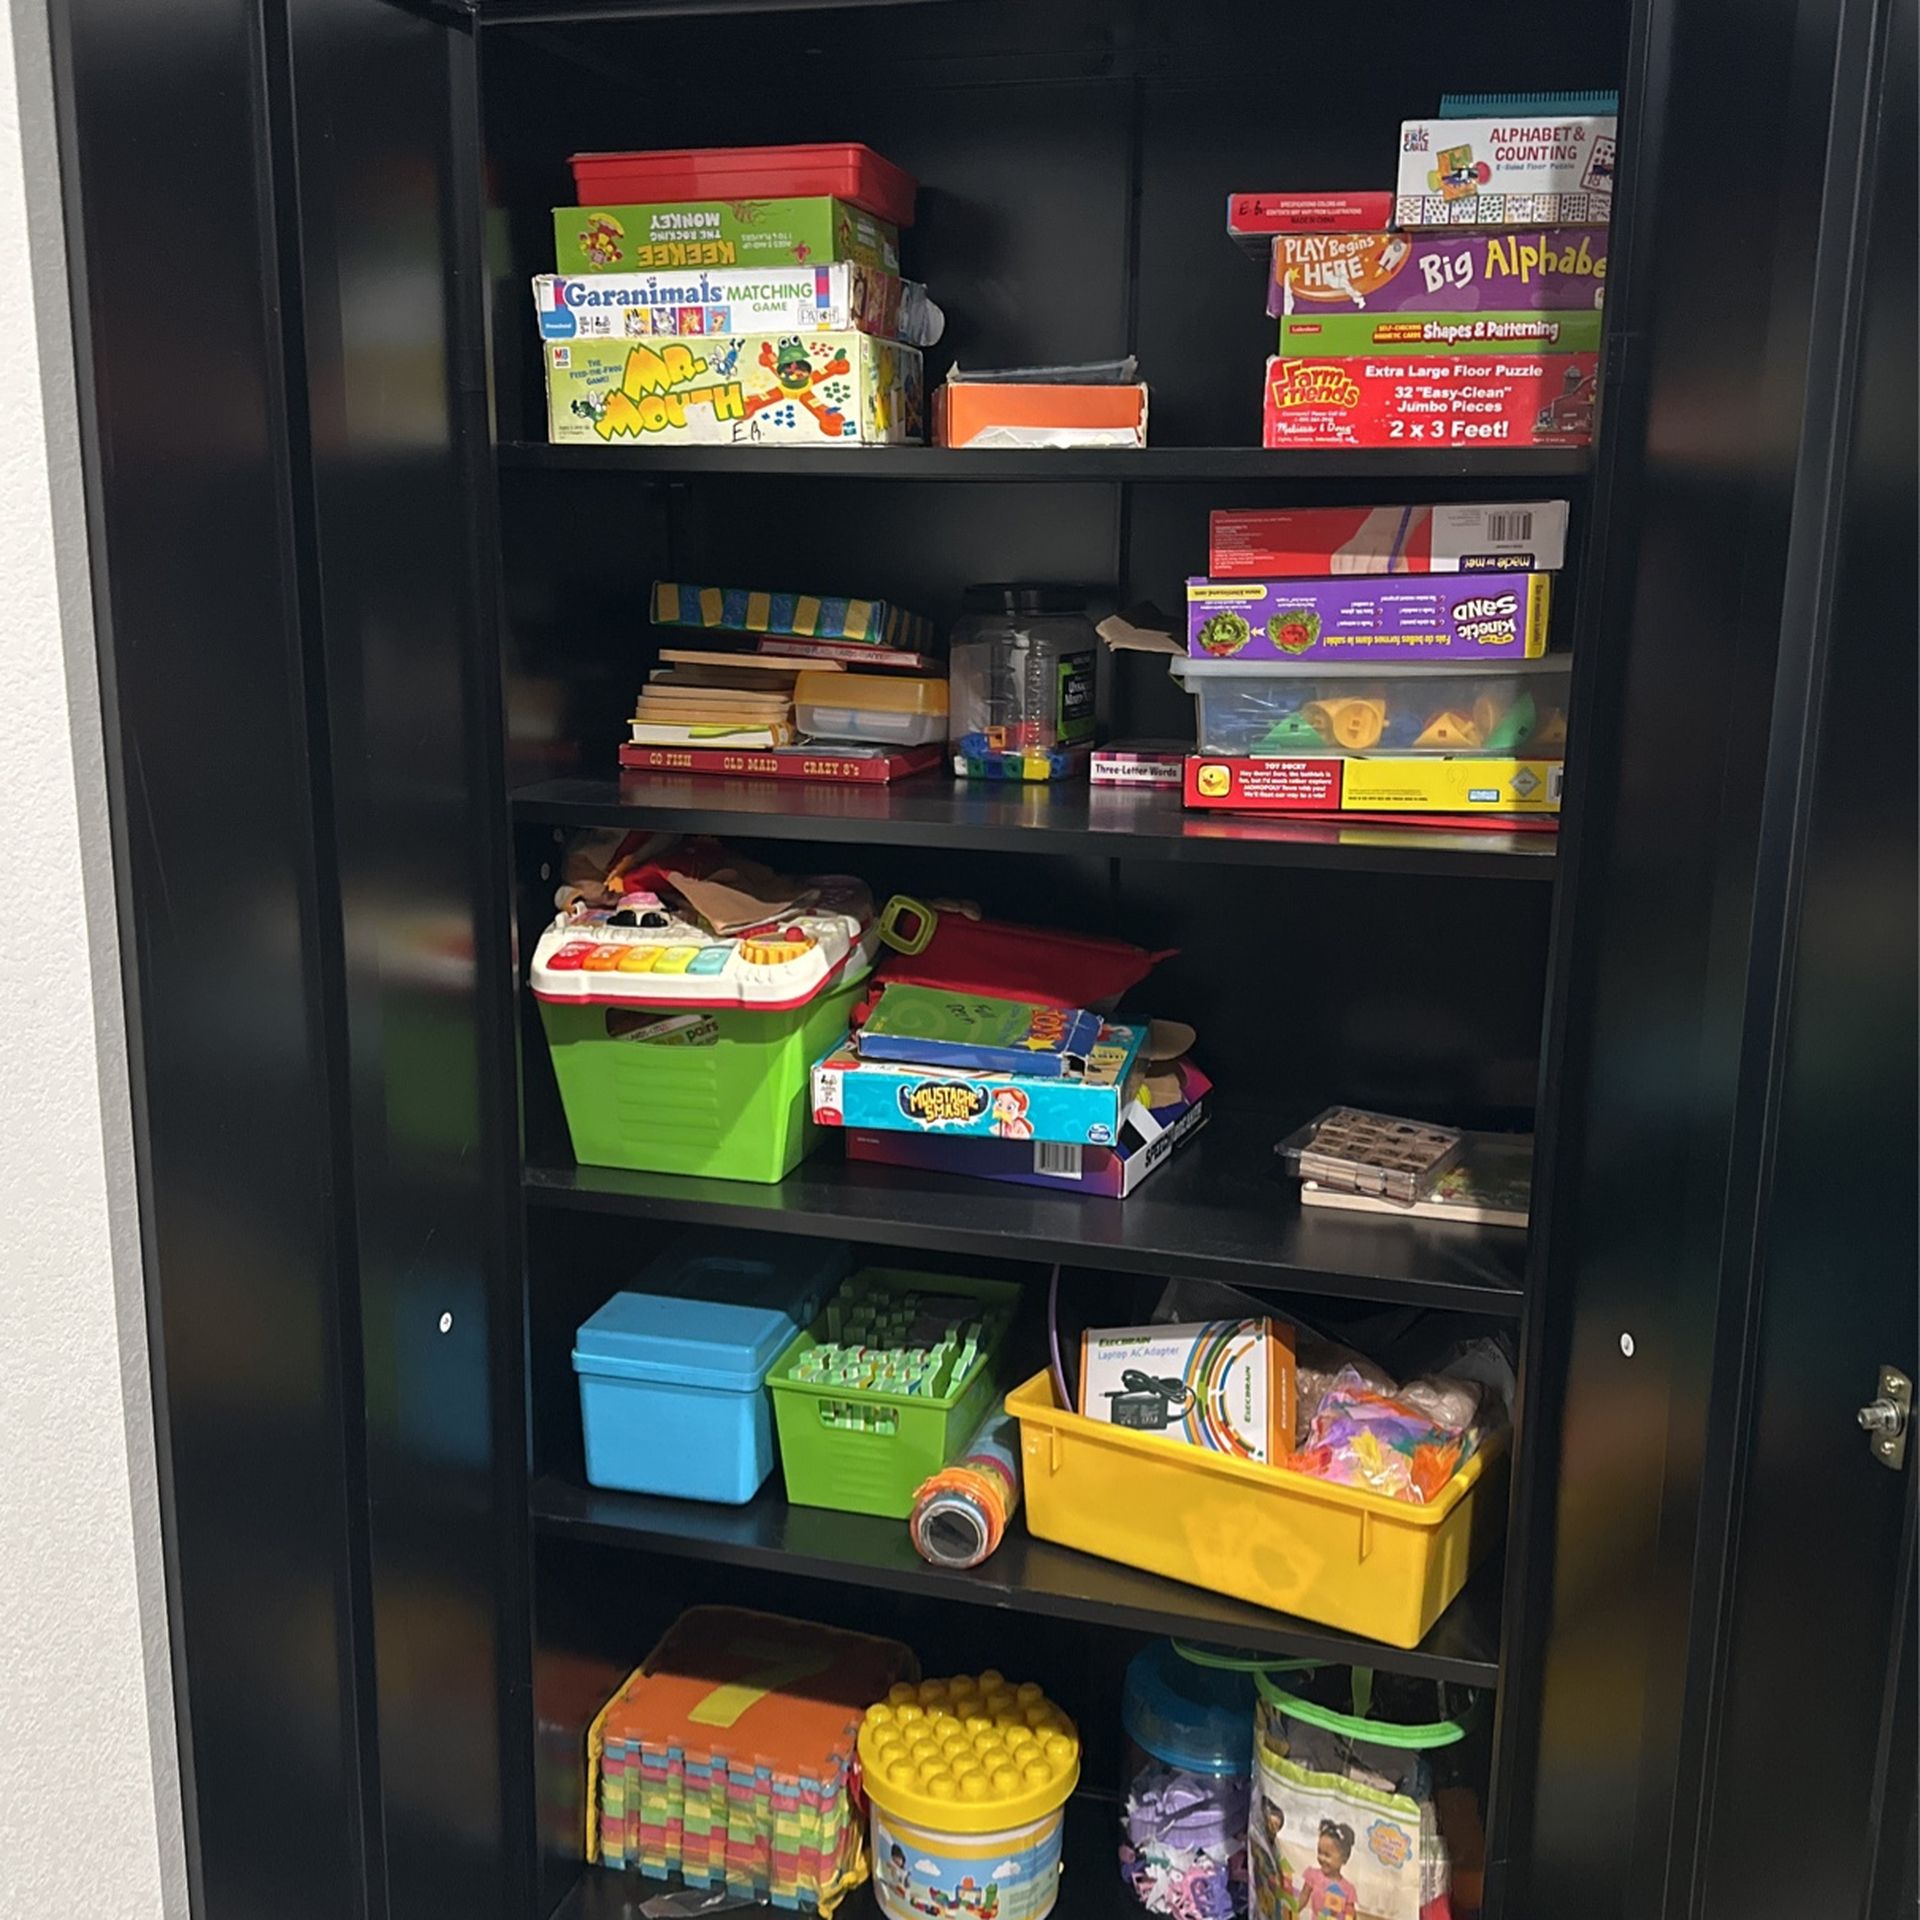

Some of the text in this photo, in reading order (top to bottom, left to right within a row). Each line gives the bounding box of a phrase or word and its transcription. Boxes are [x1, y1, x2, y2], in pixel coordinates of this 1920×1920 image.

[1404, 131, 1429, 143] ERIC
[1490, 126, 1586, 144] ALPHABET &
[1404, 143, 1429, 152] CARLE
[1495, 145, 1577, 161] COUNTING
[650, 213, 721, 229] MONKEY
[650, 230, 721, 241] THE ROCKING
[637, 240, 737, 267] KEEKEE
[1284, 236, 1375, 264] PLAY Begins
[1304, 256, 1364, 287] HERE
[1419, 251, 1474, 293] Big
[564, 275, 722, 307] Garanimals
[726, 283, 813, 301] MATCHING
[752, 301, 788, 313] GAME
[1423, 320, 1559, 342] Shapes & Patterning
[554, 349, 569, 360] MB
[622, 343, 708, 403] MR.
[1283, 360, 1346, 389] Farm
[1365, 365, 1543, 379] Extra Large Floor Puzzle
[1272, 378, 1360, 408] Friends
[1394, 386, 1512, 400] 32 "Easy-Clean"
[1397, 401, 1502, 412] Jumbo Pieces
[1276, 423, 1317, 434] Melissa
[1390, 420, 1509, 438] 2 x 3 Feet!
[1496, 556, 1531, 570] made
[1456, 619, 1517, 640] Kinetic
[650, 752, 692, 767] GO FISH
[723, 756, 778, 772] OLD MAID
[803, 760, 860, 776] CRAZY 8's
[1096, 764, 1177, 777] Three-Letter Words
[909, 1086, 979, 1112] MOUSTACHE
[925, 1104, 970, 1123] SMASH
[1098, 1336, 1152, 1348] ELECBRAIN
[1098, 1346, 1180, 1360] Laptop AC Adapter
[1243, 1366, 1252, 1424] ELECBRAIN
